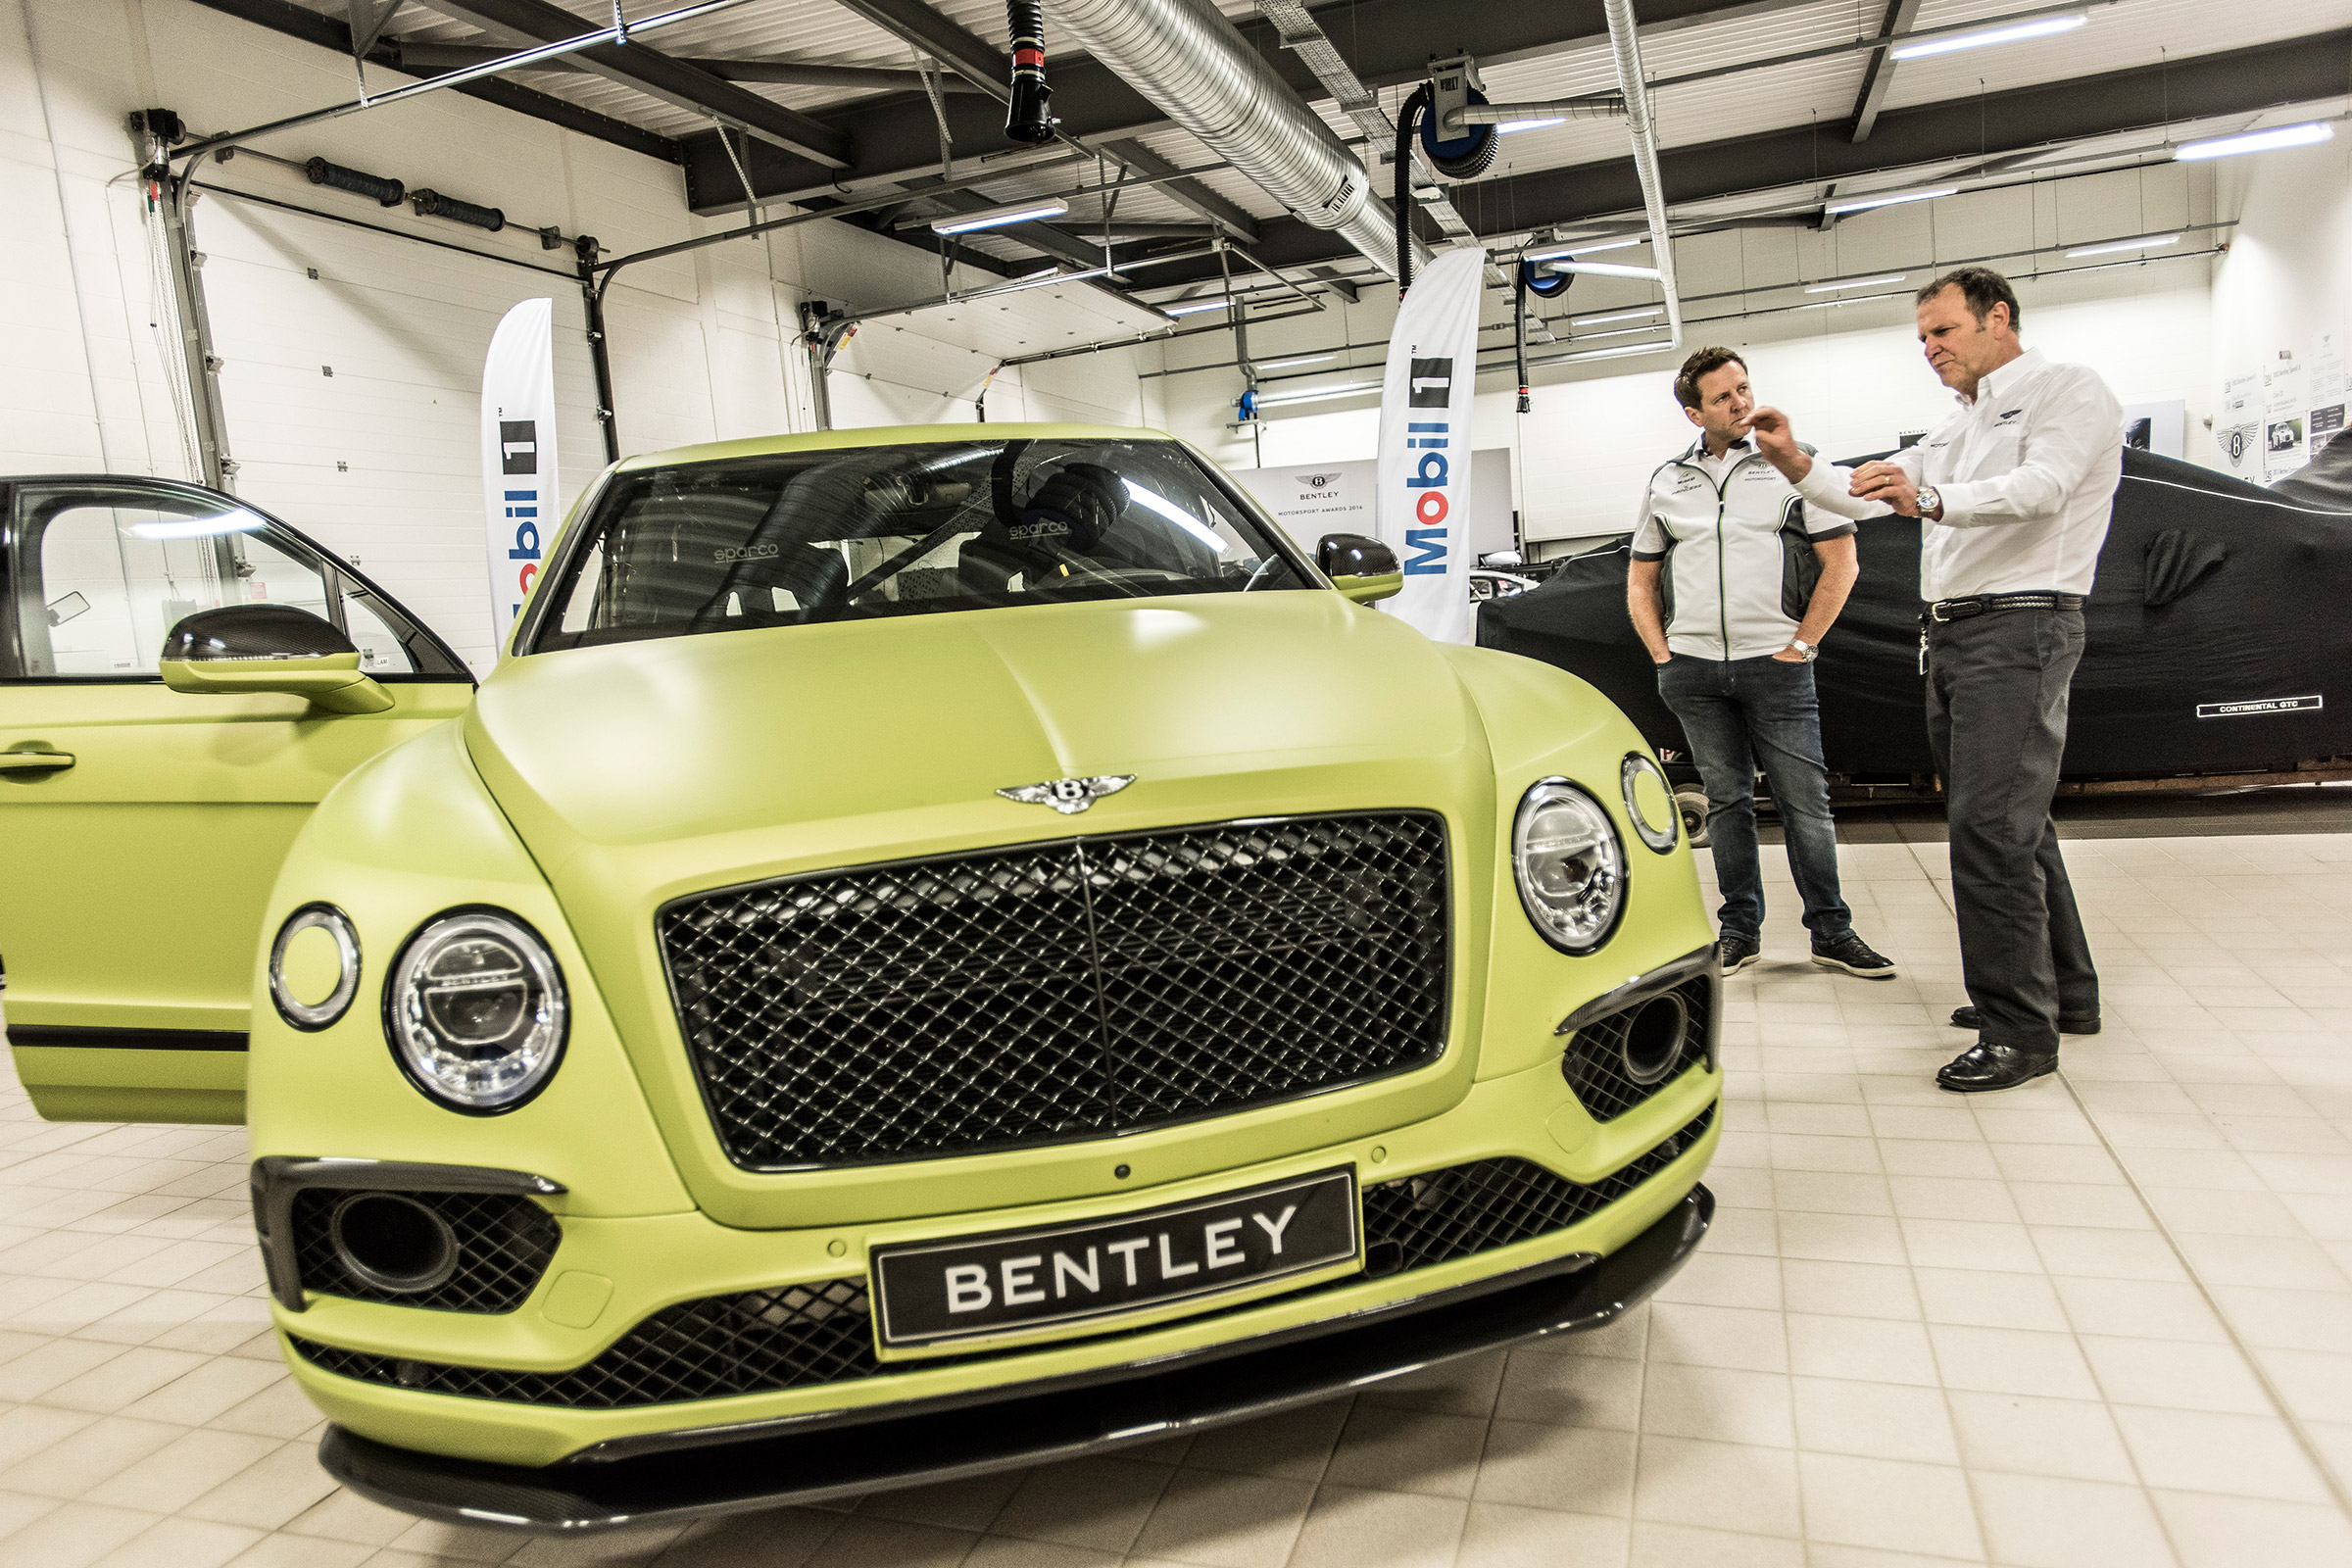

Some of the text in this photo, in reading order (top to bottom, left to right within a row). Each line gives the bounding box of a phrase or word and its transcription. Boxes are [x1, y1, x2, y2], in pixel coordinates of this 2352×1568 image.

[1299, 491, 1340, 501] BENTLEY
[1404, 422, 1448, 575] Mobil
[1277, 508, 1320, 516] MOTORSPORT
[1008, 521, 1068, 540] sparco
[714, 544, 779, 564] sparco
[2219, 700, 2299, 713] CONTINENTAL GTC
[944, 1205, 1298, 1314] BENTLEY
